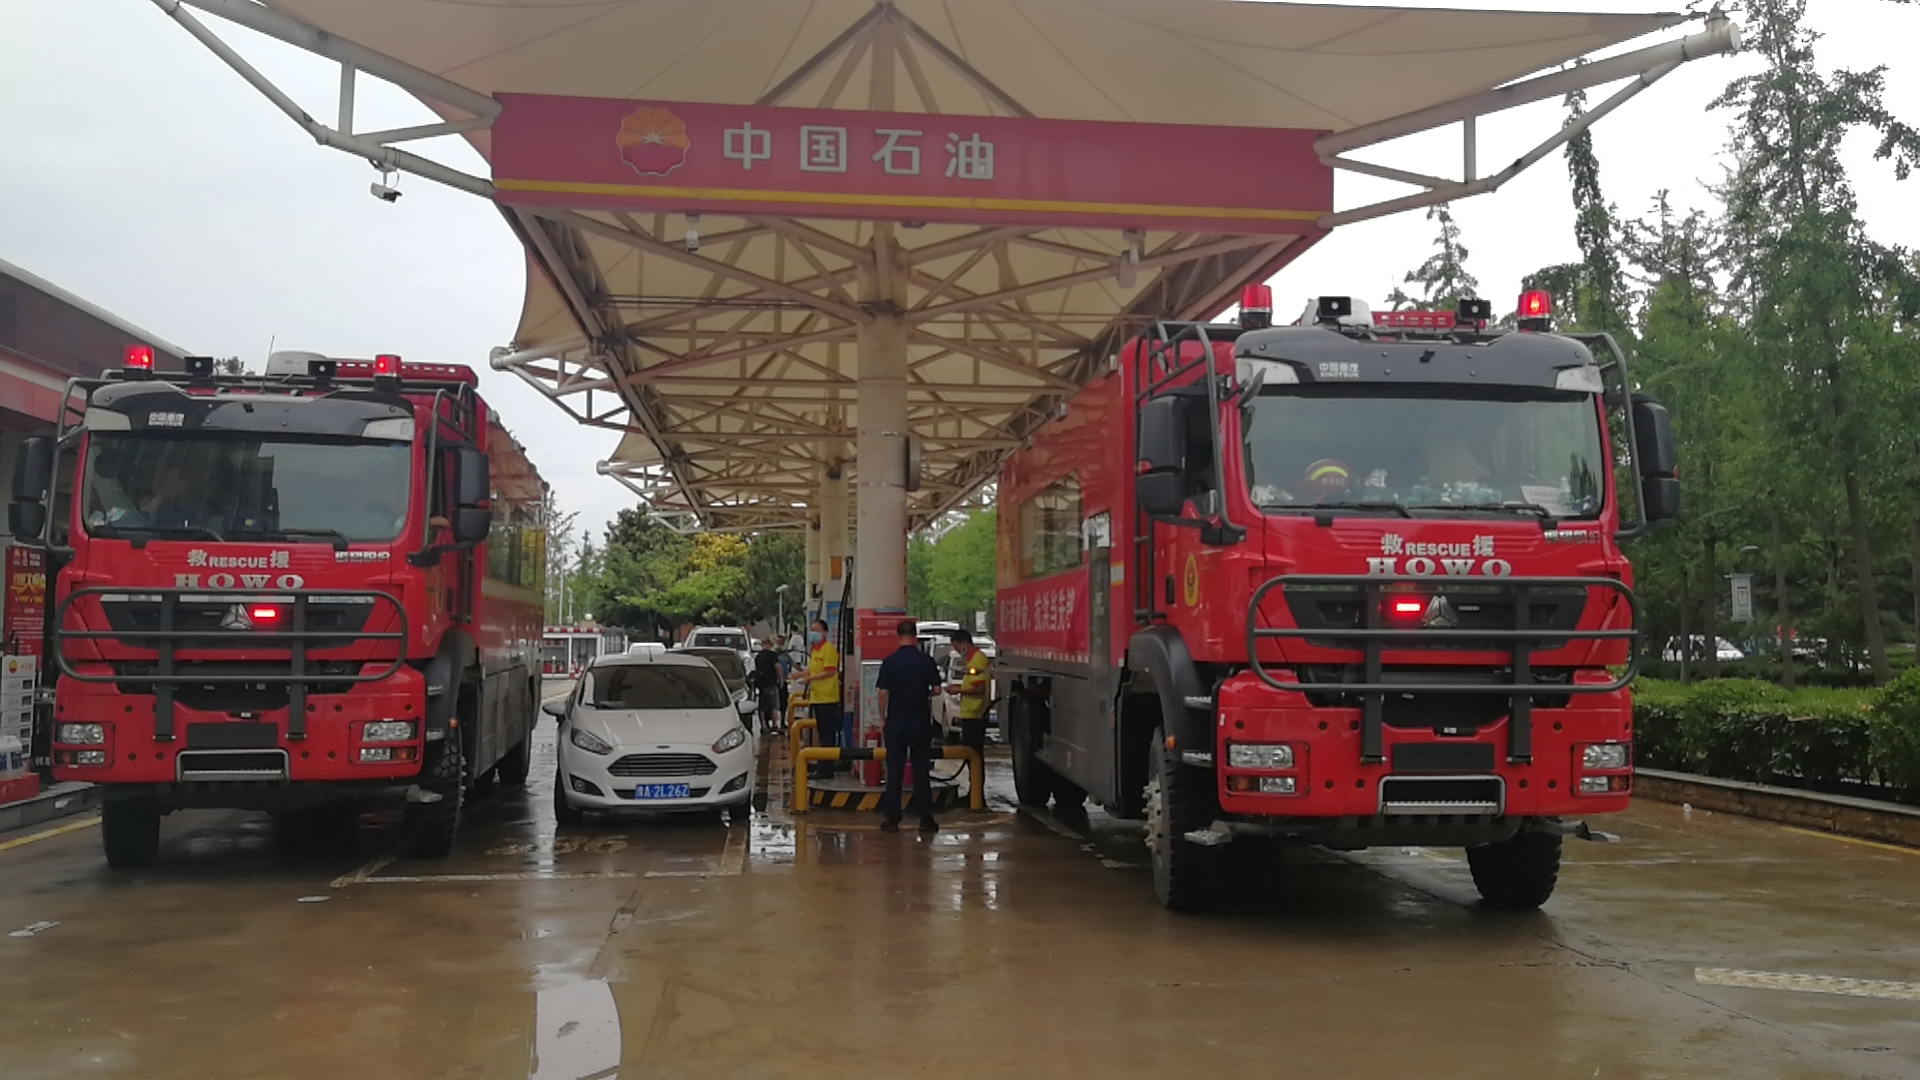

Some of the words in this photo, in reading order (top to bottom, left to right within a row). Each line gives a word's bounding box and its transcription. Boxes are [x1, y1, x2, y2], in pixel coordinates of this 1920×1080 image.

[723, 121, 995, 180] 中国石油
[1381, 534, 1403, 555] 救
[1405, 543, 1471, 556] RESCUE
[1473, 535, 1494, 557] 援
[187, 549, 207, 567] 救
[209, 556, 268, 568] RESCUE
[270, 550, 289, 568] 援
[1366, 557, 1512, 577] HOWO
[174, 573, 304, 590] HOWO
